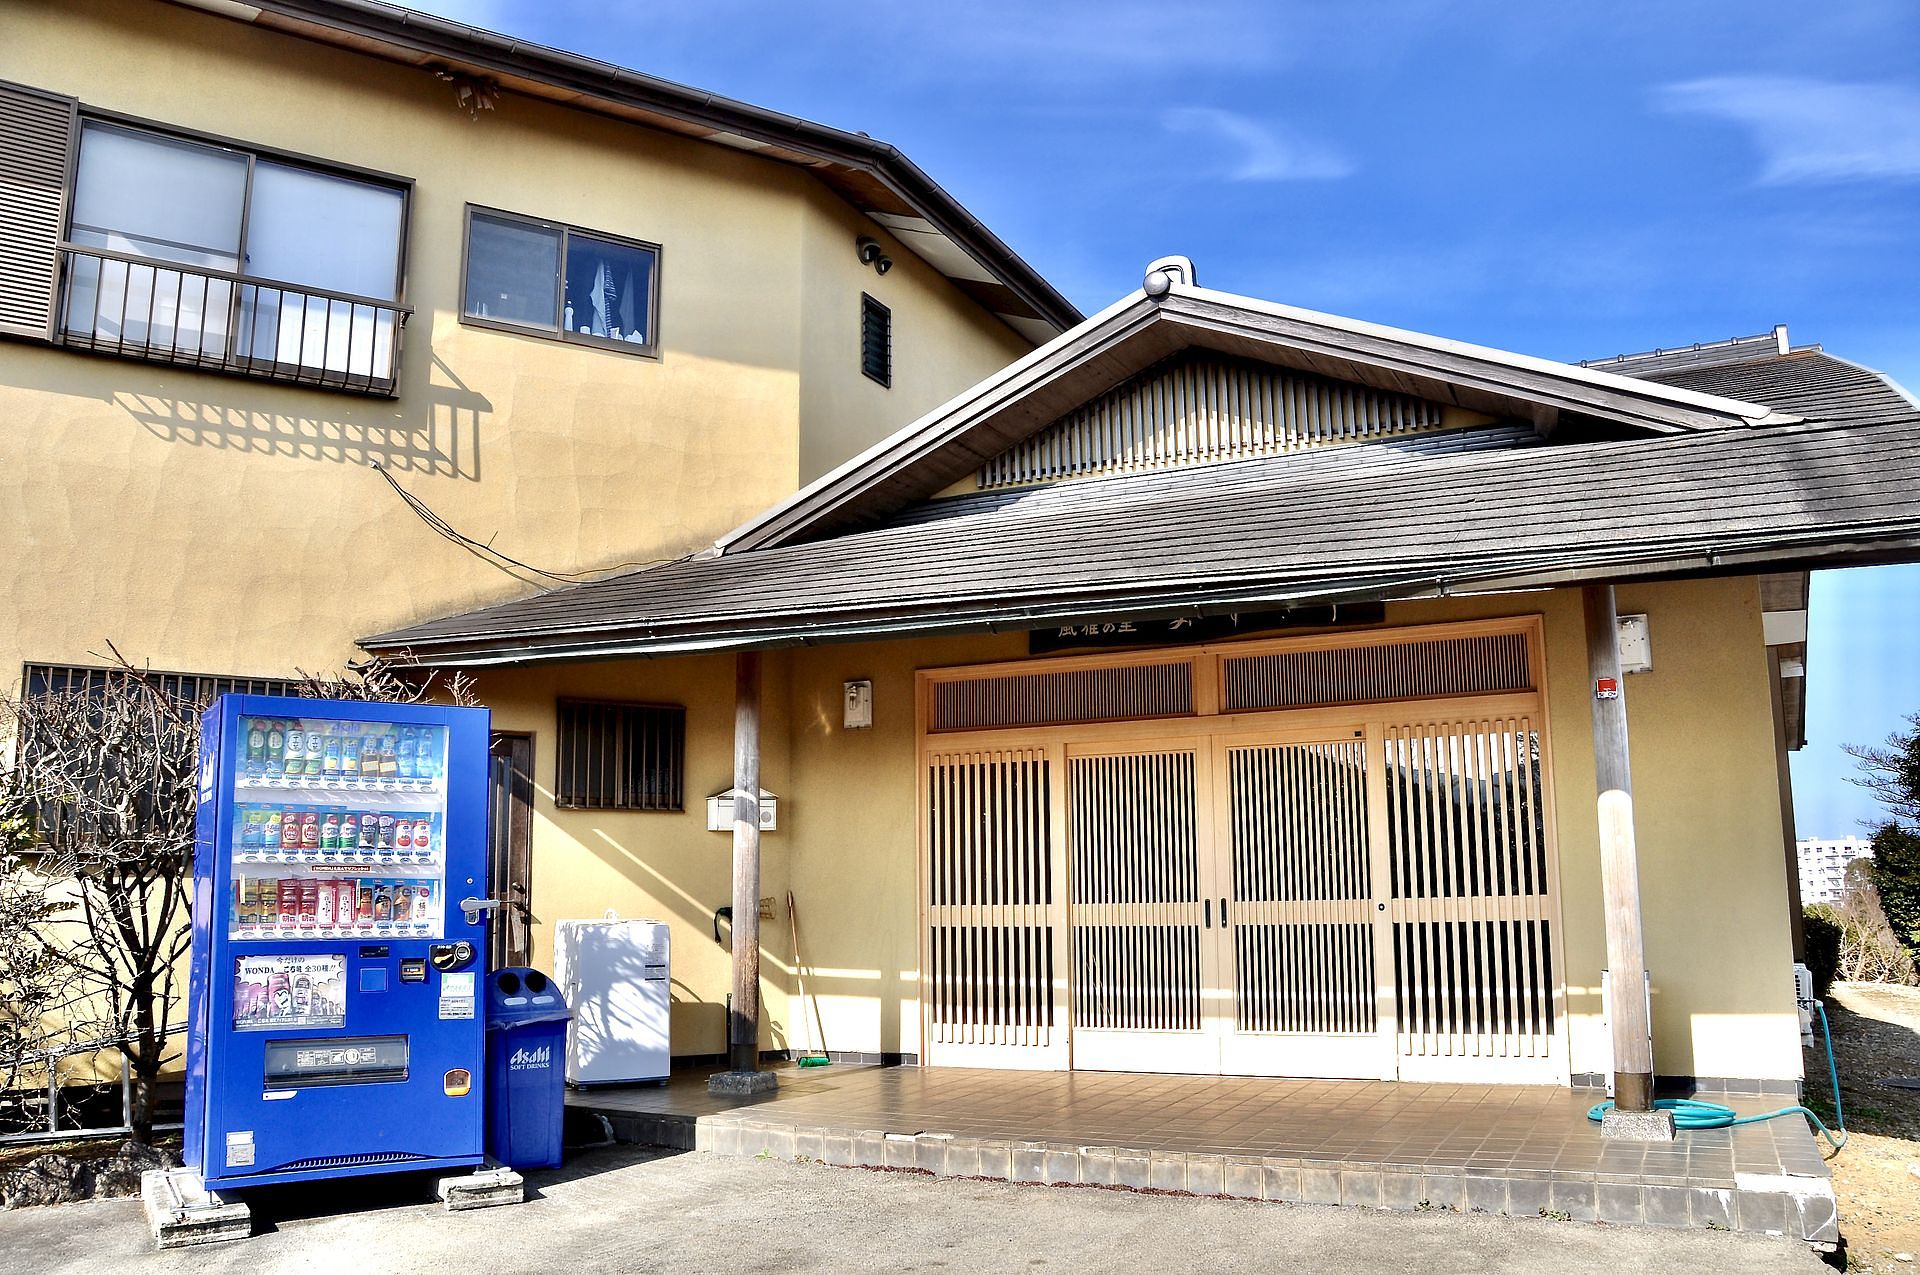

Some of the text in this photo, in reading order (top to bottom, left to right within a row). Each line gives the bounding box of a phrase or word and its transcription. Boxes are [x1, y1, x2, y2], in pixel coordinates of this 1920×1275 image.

[245, 966, 275, 975] WONDA
[510, 1046, 550, 1064] Asahi
[510, 1062, 550, 1071] SOFT DRINKS
